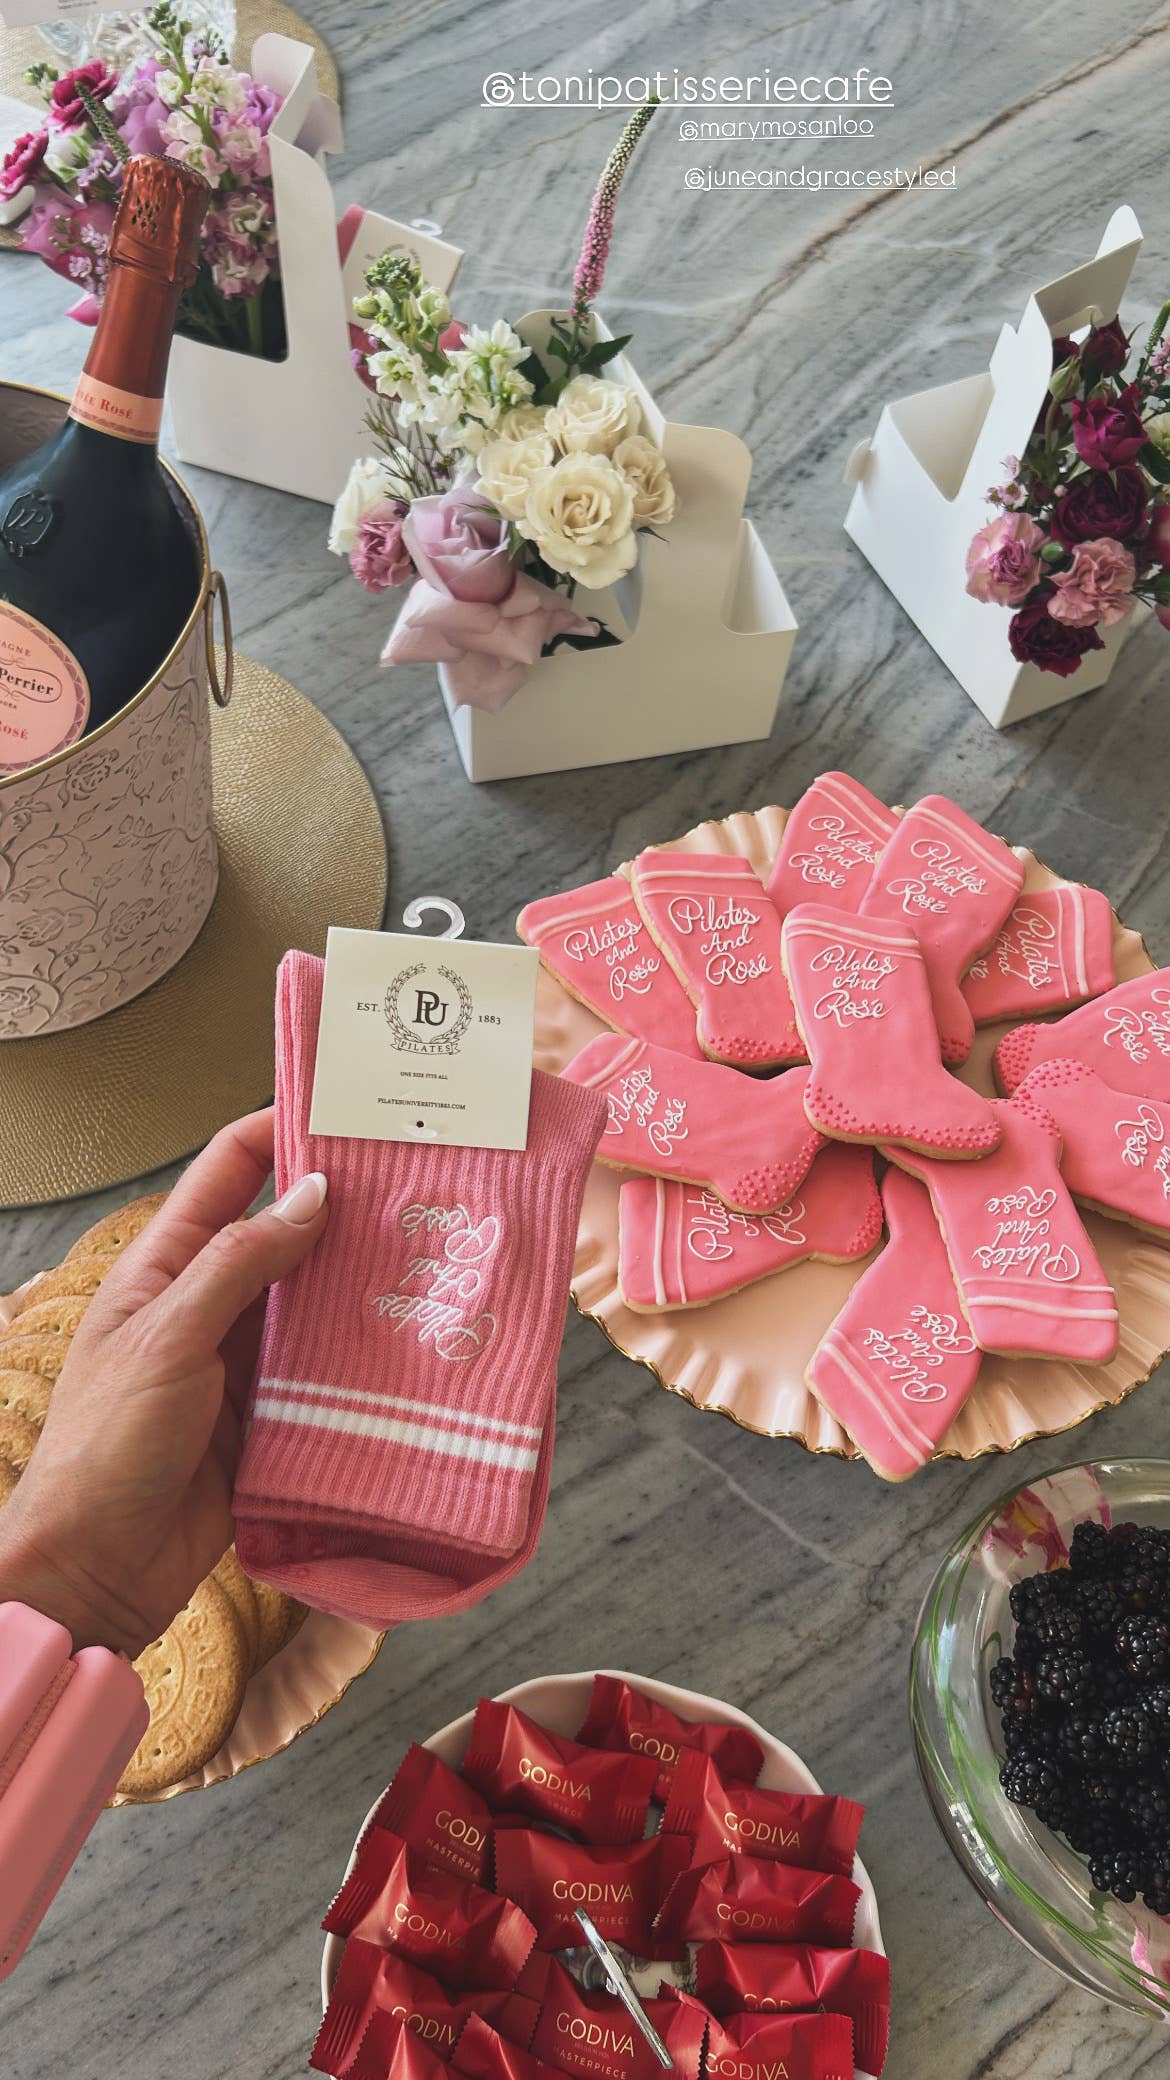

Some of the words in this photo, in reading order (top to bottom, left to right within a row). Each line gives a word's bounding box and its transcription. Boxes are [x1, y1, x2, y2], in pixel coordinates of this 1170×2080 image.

[0, 639, 31, 657] AGNE
[0, 667, 55, 696] Perrier
[808, 815, 882, 864] Pilates
[814, 843, 867, 870] And
[788, 852, 848, 889] Rosé
[910, 838, 989, 896] Pilates
[920, 870, 965, 898] And
[668, 896, 760, 935] Pilates
[886, 878, 951, 917] Rosé
[563, 917, 643, 961] Pilates
[605, 936, 640, 966] And
[701, 923, 753, 955] And
[1012, 907, 1060, 991] Pilates
[609, 955, 661, 1001] Rosé
[705, 952, 773, 986] Rosé
[809, 944, 898, 975] Pilates
[832, 970, 888, 991] And
[356, 1001, 381, 1013] EST.
[478, 1014, 502, 1025] 1883
[813, 989, 891, 1028] Rosé
[401, 1040, 451, 1054] PILATES
[1104, 1006, 1148, 1065] Rosé
[634, 1084, 660, 1126] And
[648, 1098, 689, 1156] Rosé
[1115, 1103, 1165, 1168] Rosé
[985, 1185, 1057, 1218] Rosé
[993, 1219, 1050, 1248] And
[399, 1257, 481, 1299] And
[971, 1242, 1081, 1282] Pilates
[371, 1294, 497, 1360] Pilates
[909, 1304, 977, 1354] Rosé
[862, 1327, 948, 1403] Pilates
[888, 1327, 943, 1367] And
[629, 1732, 681, 1765] GODI
[519, 1757, 592, 1801] GODIVA
[435, 1810, 487, 1852] GODI
[724, 1811, 801, 1849] GODIVA
[425, 1837, 481, 1877] MASTERPIE
[552, 1880, 634, 1903] GODIVA
[394, 1903, 464, 1947] GODIV
[556, 2012, 634, 2058] GODIVA
[554, 2045, 627, 2079] ASTERPIECE
[705, 2052, 789, 2080] GODIVA
